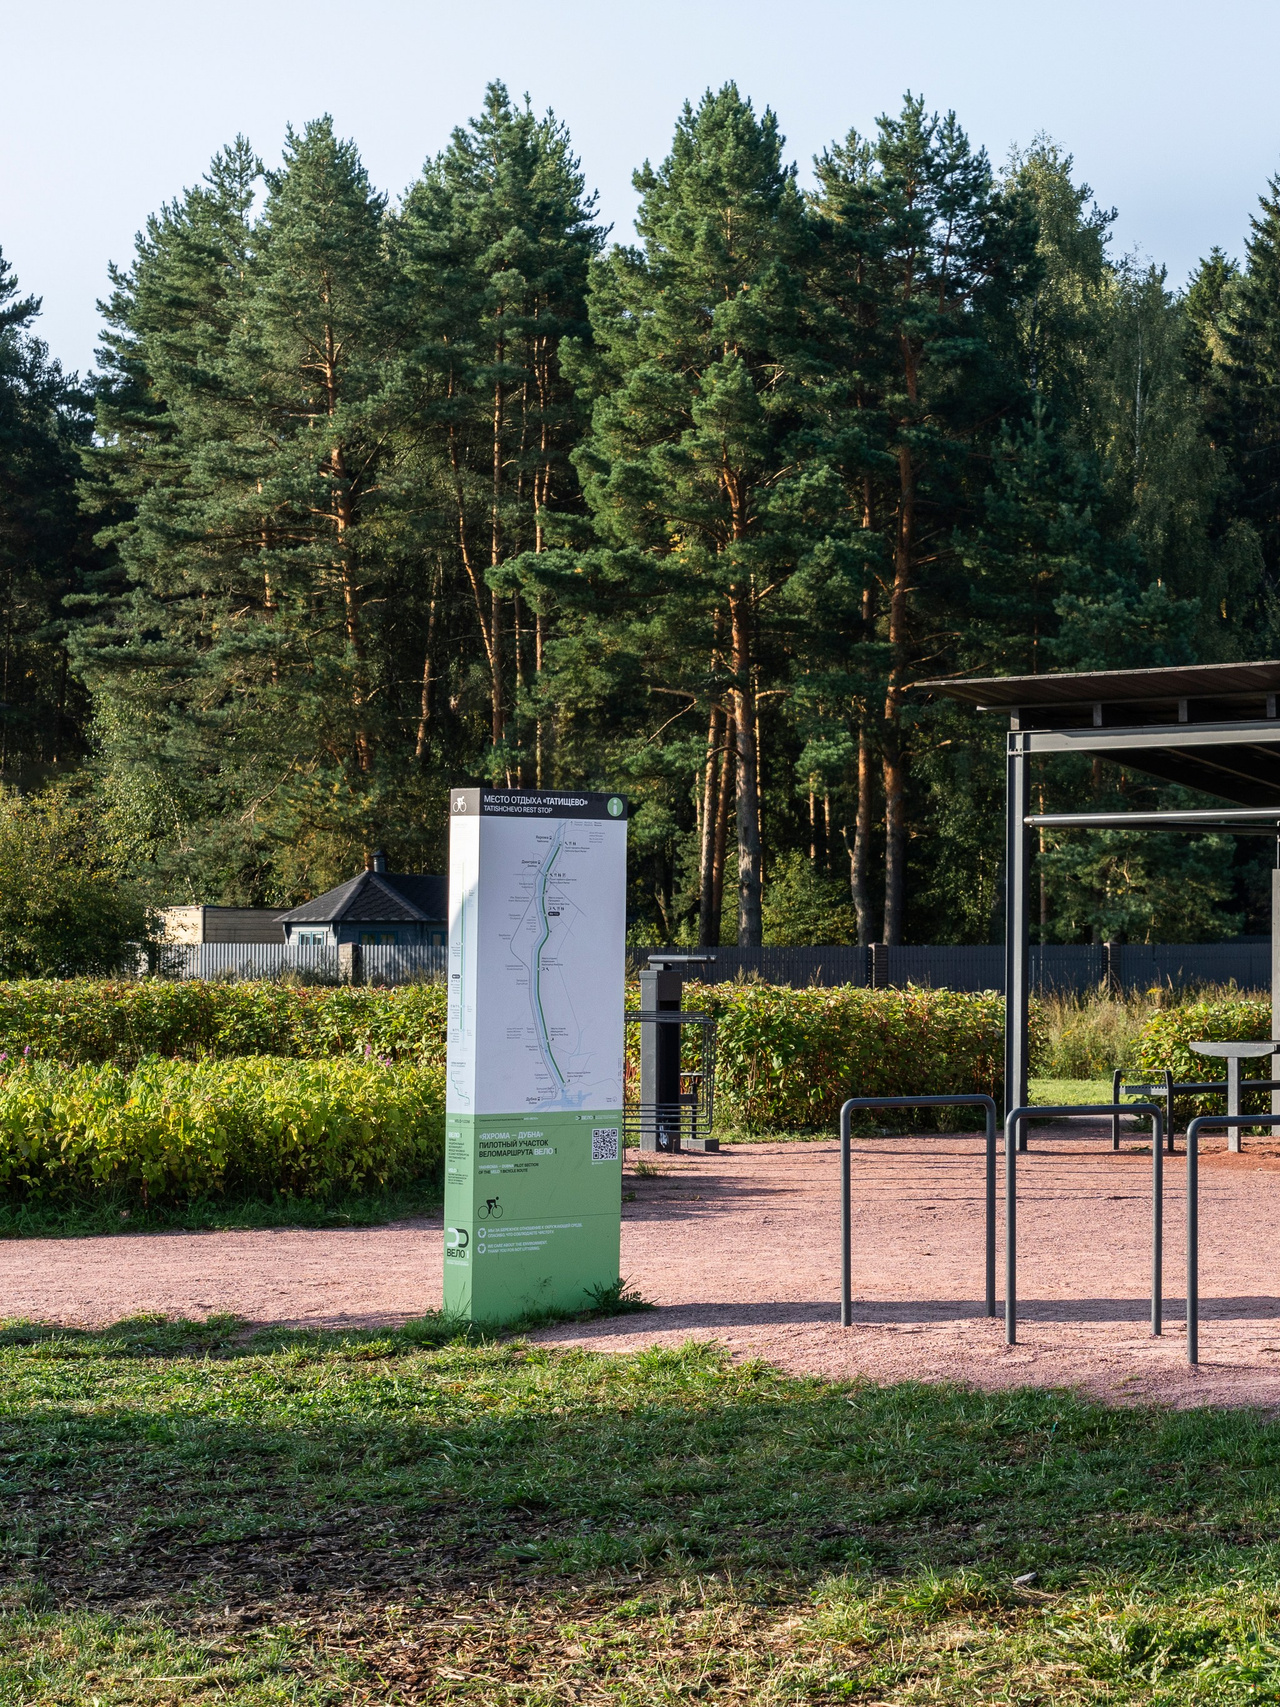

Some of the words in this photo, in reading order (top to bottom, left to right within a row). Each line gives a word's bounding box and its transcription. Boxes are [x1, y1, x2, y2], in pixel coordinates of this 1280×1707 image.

[484, 795, 510, 803] МЕСТО
[511, 796, 542, 805] ОТДЫХА
[543, 797, 588, 807] «ТАТИЩЕВО»
[484, 805, 522, 813] TATISHCHEVO
[518, 1131, 544, 1139] ДУБНА»
[479, 1140, 517, 1148] ПИЛОТНЫЙ
[479, 1149, 533, 1157] ВЕЛОМАРШРУТА
[447, 1248, 465, 1258] ВЕЛО
